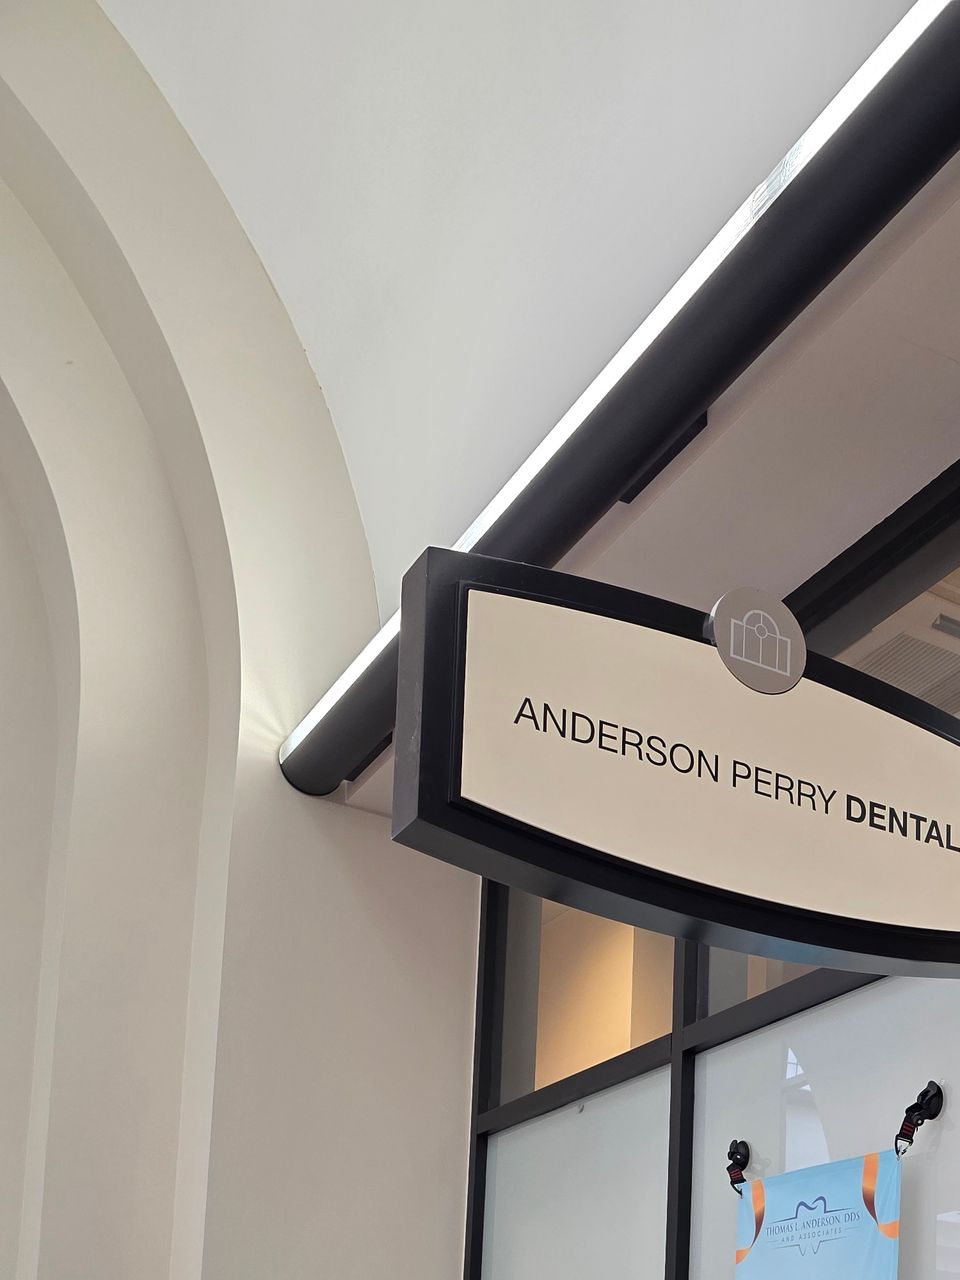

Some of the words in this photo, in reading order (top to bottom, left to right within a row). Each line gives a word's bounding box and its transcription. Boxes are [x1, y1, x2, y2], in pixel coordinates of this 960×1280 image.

[514, 698, 718, 782] ANDERSON
[733, 760, 838, 815] PERRY
[847, 794, 960, 853] DENTAL
[766, 1223, 793, 1237] THOMAS
[844, 1211, 861, 1223] DDS
[781, 1235, 795, 1243] AND
[799, 1227, 842, 1241] ASSOCIATES
